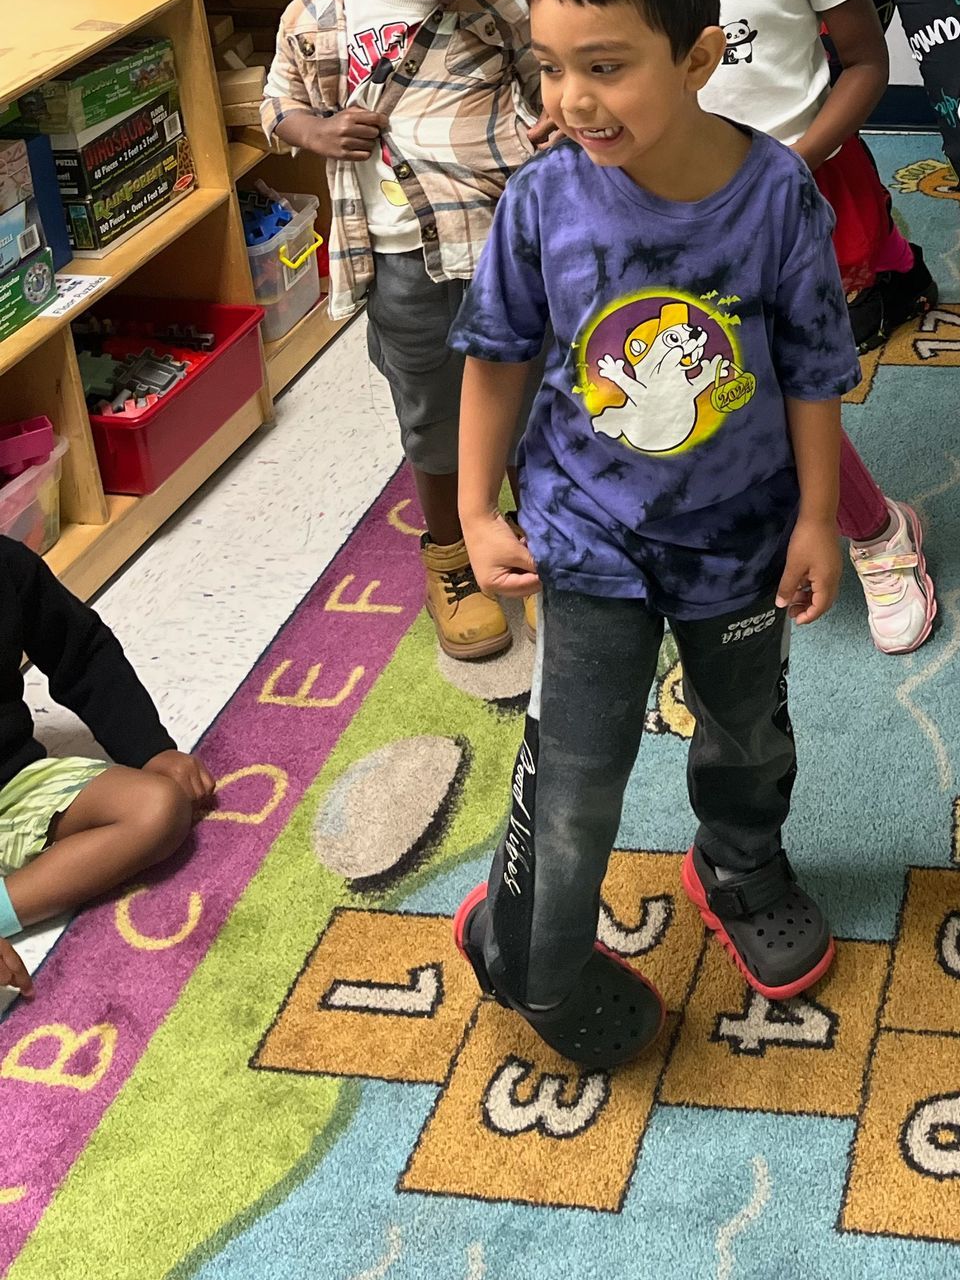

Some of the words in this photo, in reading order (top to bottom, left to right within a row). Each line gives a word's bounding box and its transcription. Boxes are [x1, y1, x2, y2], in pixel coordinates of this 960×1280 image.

[718, 380, 754, 407] 2024
[3, 1022, 118, 1092] B
[115, 884, 203, 953] C
[256, 658, 365, 709] E
[323, 573, 406, 616] F
[504, 813, 532, 898] Vibes
[318, 960, 445, 1020] 1
[709, 994, 840, 1058] 4
[481, 1054, 612, 1139] 3
